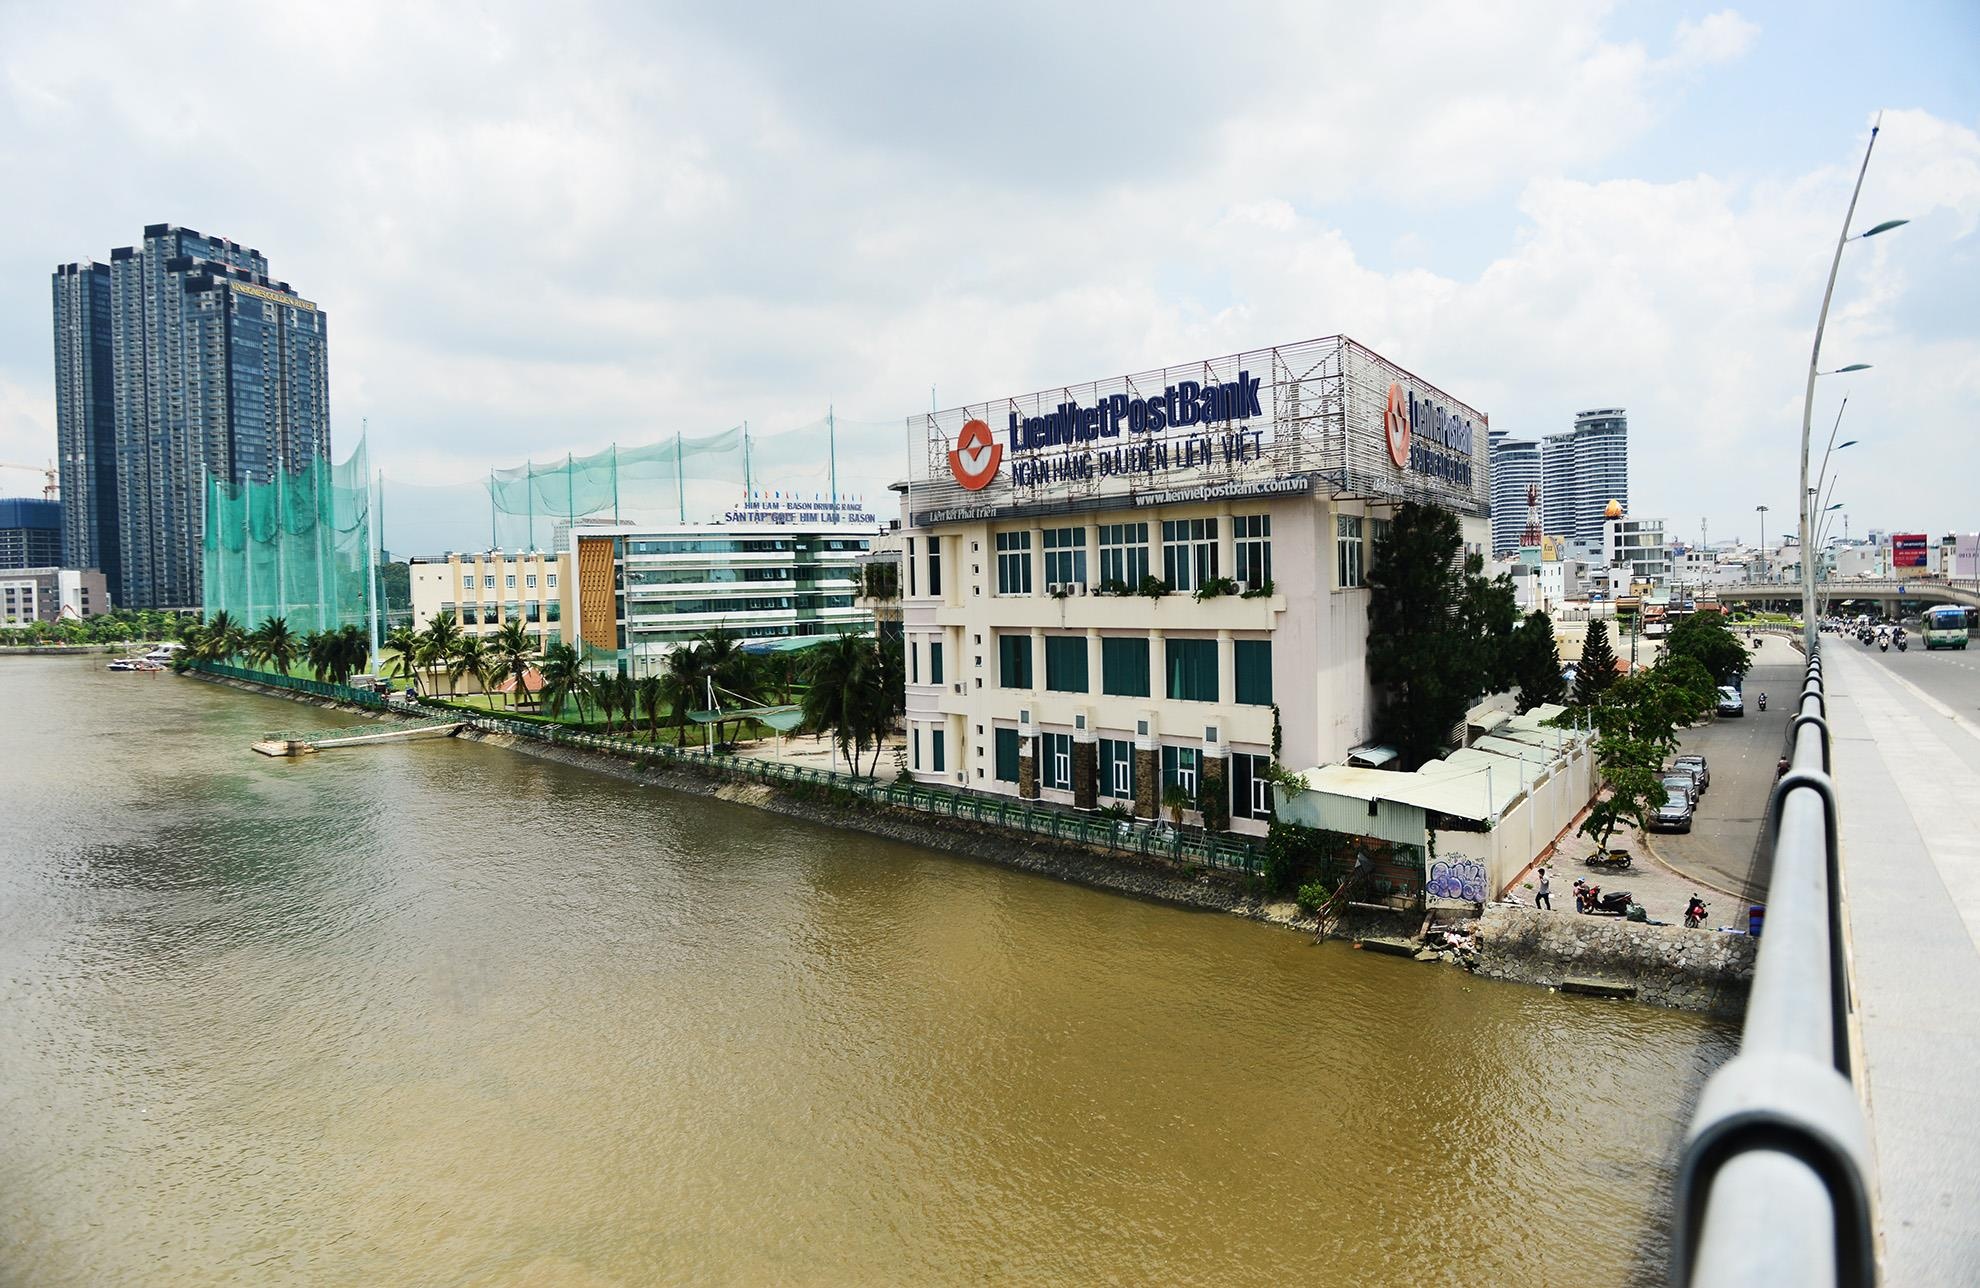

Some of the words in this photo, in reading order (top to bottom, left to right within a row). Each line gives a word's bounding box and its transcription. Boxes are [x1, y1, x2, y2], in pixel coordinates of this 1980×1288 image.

[1009, 370, 1262, 451] LienVietPostBank
[1011, 455, 1049, 489] NGÂN
[1053, 449, 1093, 482] HÀNG
[1176, 432, 1211, 468] LIÊN
[1221, 426, 1263, 465] VIỆT
[1135, 477, 1308, 506] www.lienvietpostbank.com.vn
[725, 510, 746, 522] SÂN
[771, 512, 796, 523] GOLF
[800, 512, 818, 522] HIM
[821, 513, 840, 523] LAM
[849, 514, 876, 523] BASON
[745, 502, 760, 510] HIM
[762, 502, 780, 510] LAM
[787, 502, 812, 510] BASON
[813, 503, 840, 511] DRIVING
[841, 503, 863, 512] RANGE
